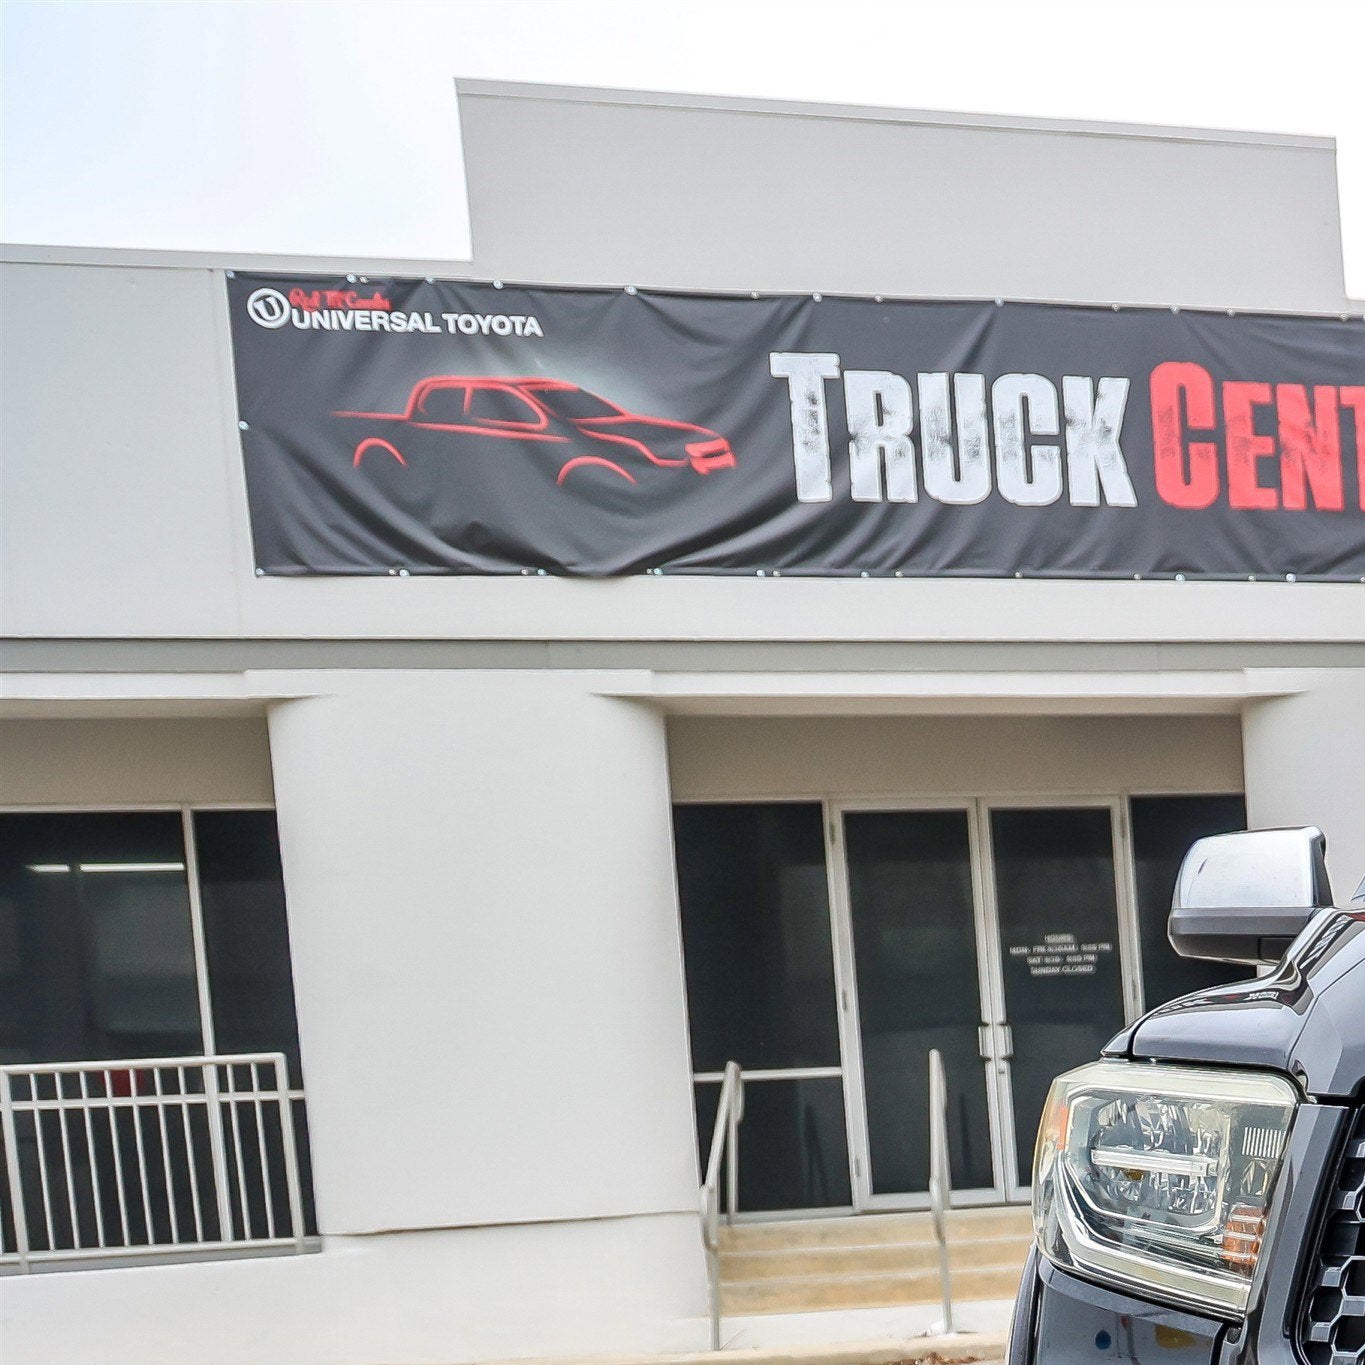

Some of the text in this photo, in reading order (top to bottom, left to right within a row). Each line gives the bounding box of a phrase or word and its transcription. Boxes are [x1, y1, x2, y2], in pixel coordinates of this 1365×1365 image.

[291, 308, 544, 338] UNIVERSAL TOYOTA
[769, 351, 1139, 508] TRUCK
